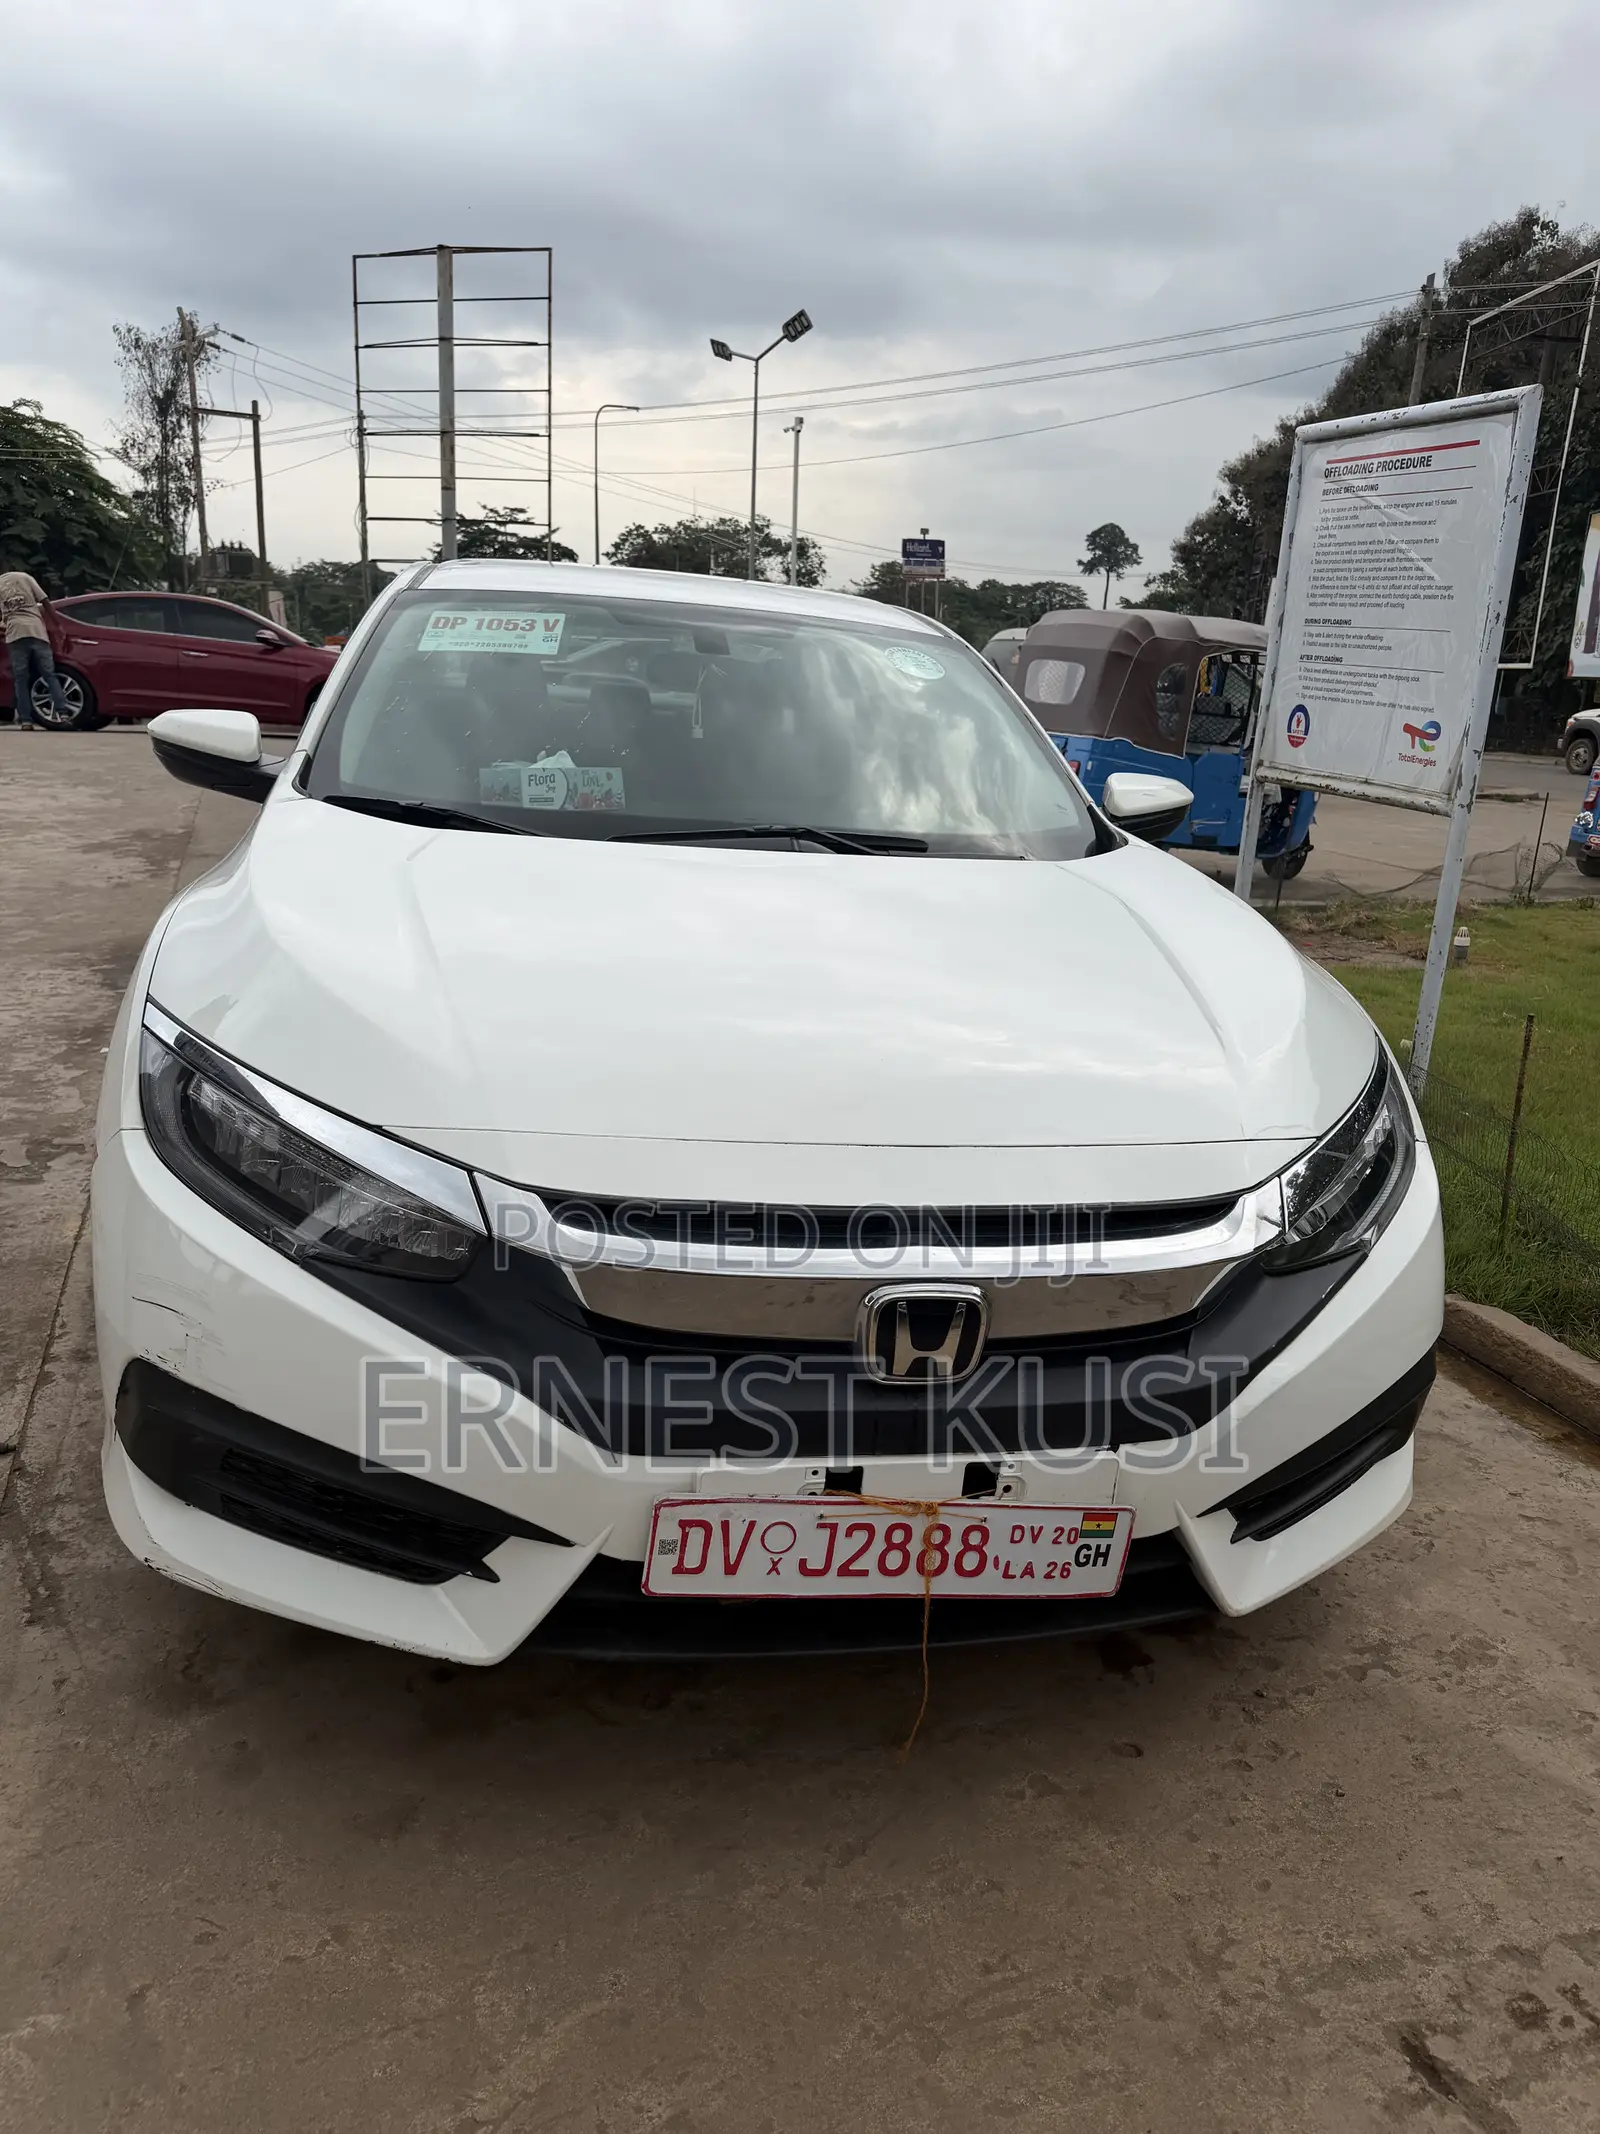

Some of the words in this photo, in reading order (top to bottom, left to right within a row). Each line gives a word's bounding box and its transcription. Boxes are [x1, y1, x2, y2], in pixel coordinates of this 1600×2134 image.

[1324, 462, 1373, 478] OFFLOADING
[1376, 455, 1432, 472] PROCEDURE
[1322, 486, 1343, 496] BEFORE
[1343, 484, 1379, 494] OFFLOADING
[431, 616, 467, 630] DP
[475, 617, 537, 632] 1053
[543, 618, 560, 633] V
[1322, 618, 1352, 626] OFFLOADING
[1314, 655, 1343, 663] OFFLOADING
[1398, 752, 1437, 768] TotalEnergies
[528, 773, 555, 787] Flora
[1010, 1525, 1044, 1545] DV
[1052, 1526, 1080, 1545] 20
[672, 1518, 755, 1576] DV
[1074, 1543, 1112, 1568] GH
[1001, 1560, 1036, 1580] LA
[1043, 1560, 1072, 1580] 26
